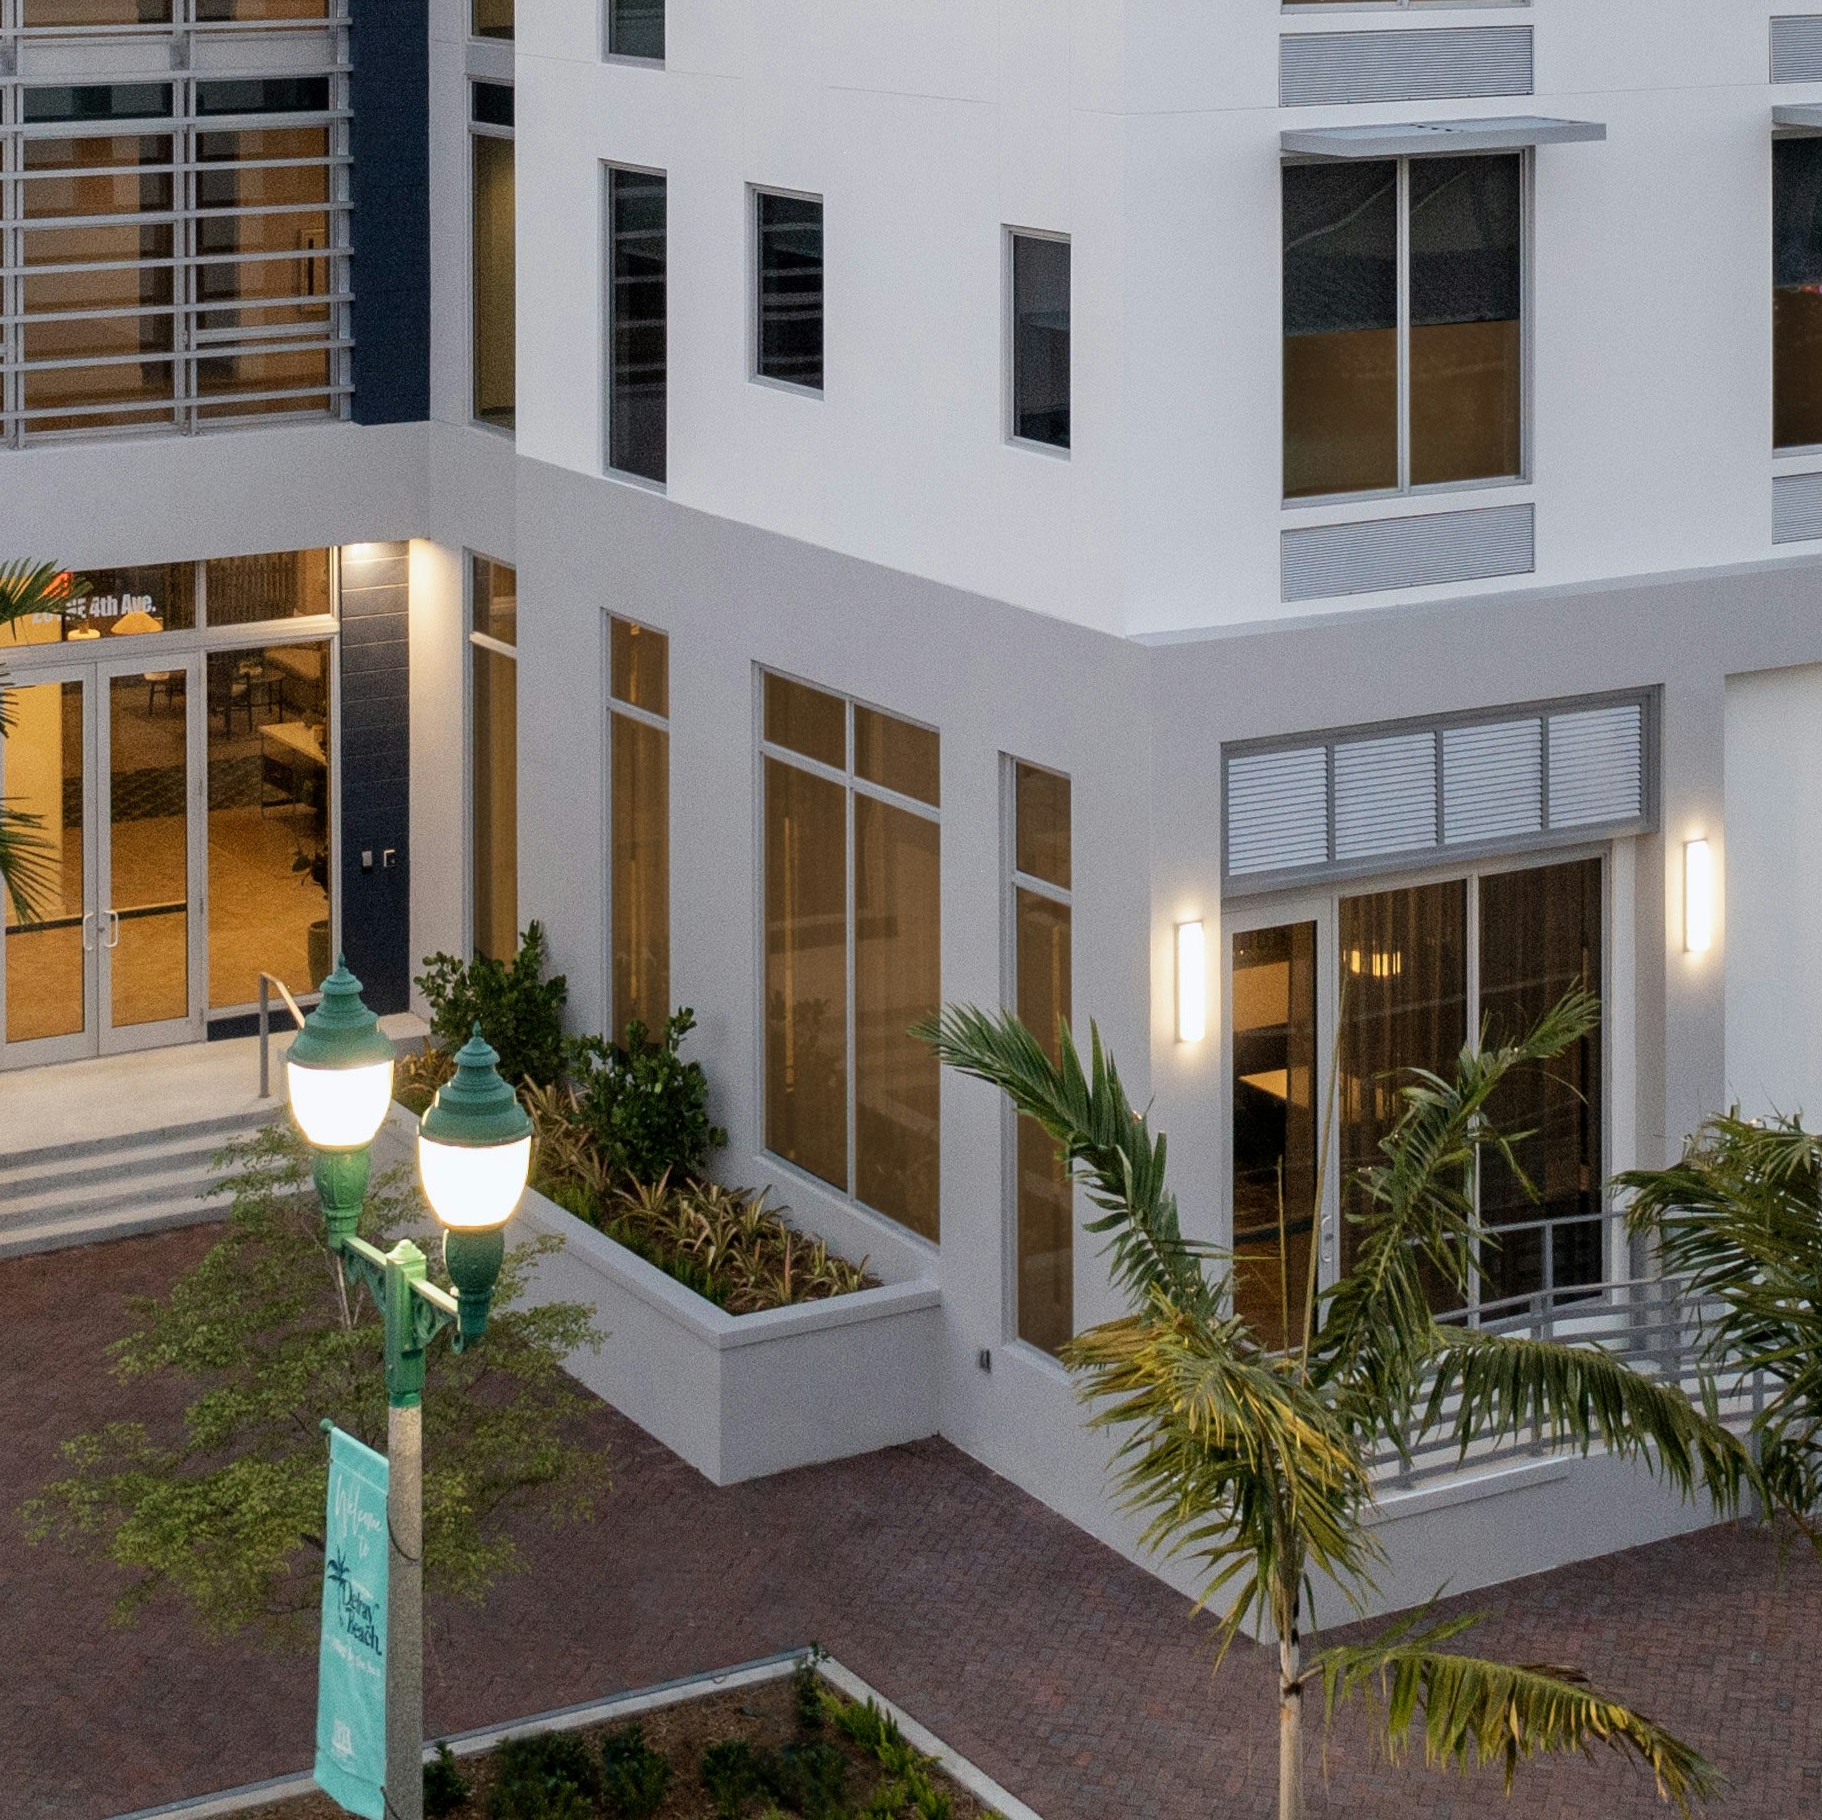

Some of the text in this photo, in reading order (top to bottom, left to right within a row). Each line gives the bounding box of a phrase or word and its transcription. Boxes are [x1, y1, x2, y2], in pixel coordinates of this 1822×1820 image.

[89, 594, 118, 618] 4th
[121, 593, 157, 614] Ave.
[334, 1474, 382, 1537] Welcome
[342, 1581, 373, 1625] Delray
[345, 1607, 382, 1656] Beach
